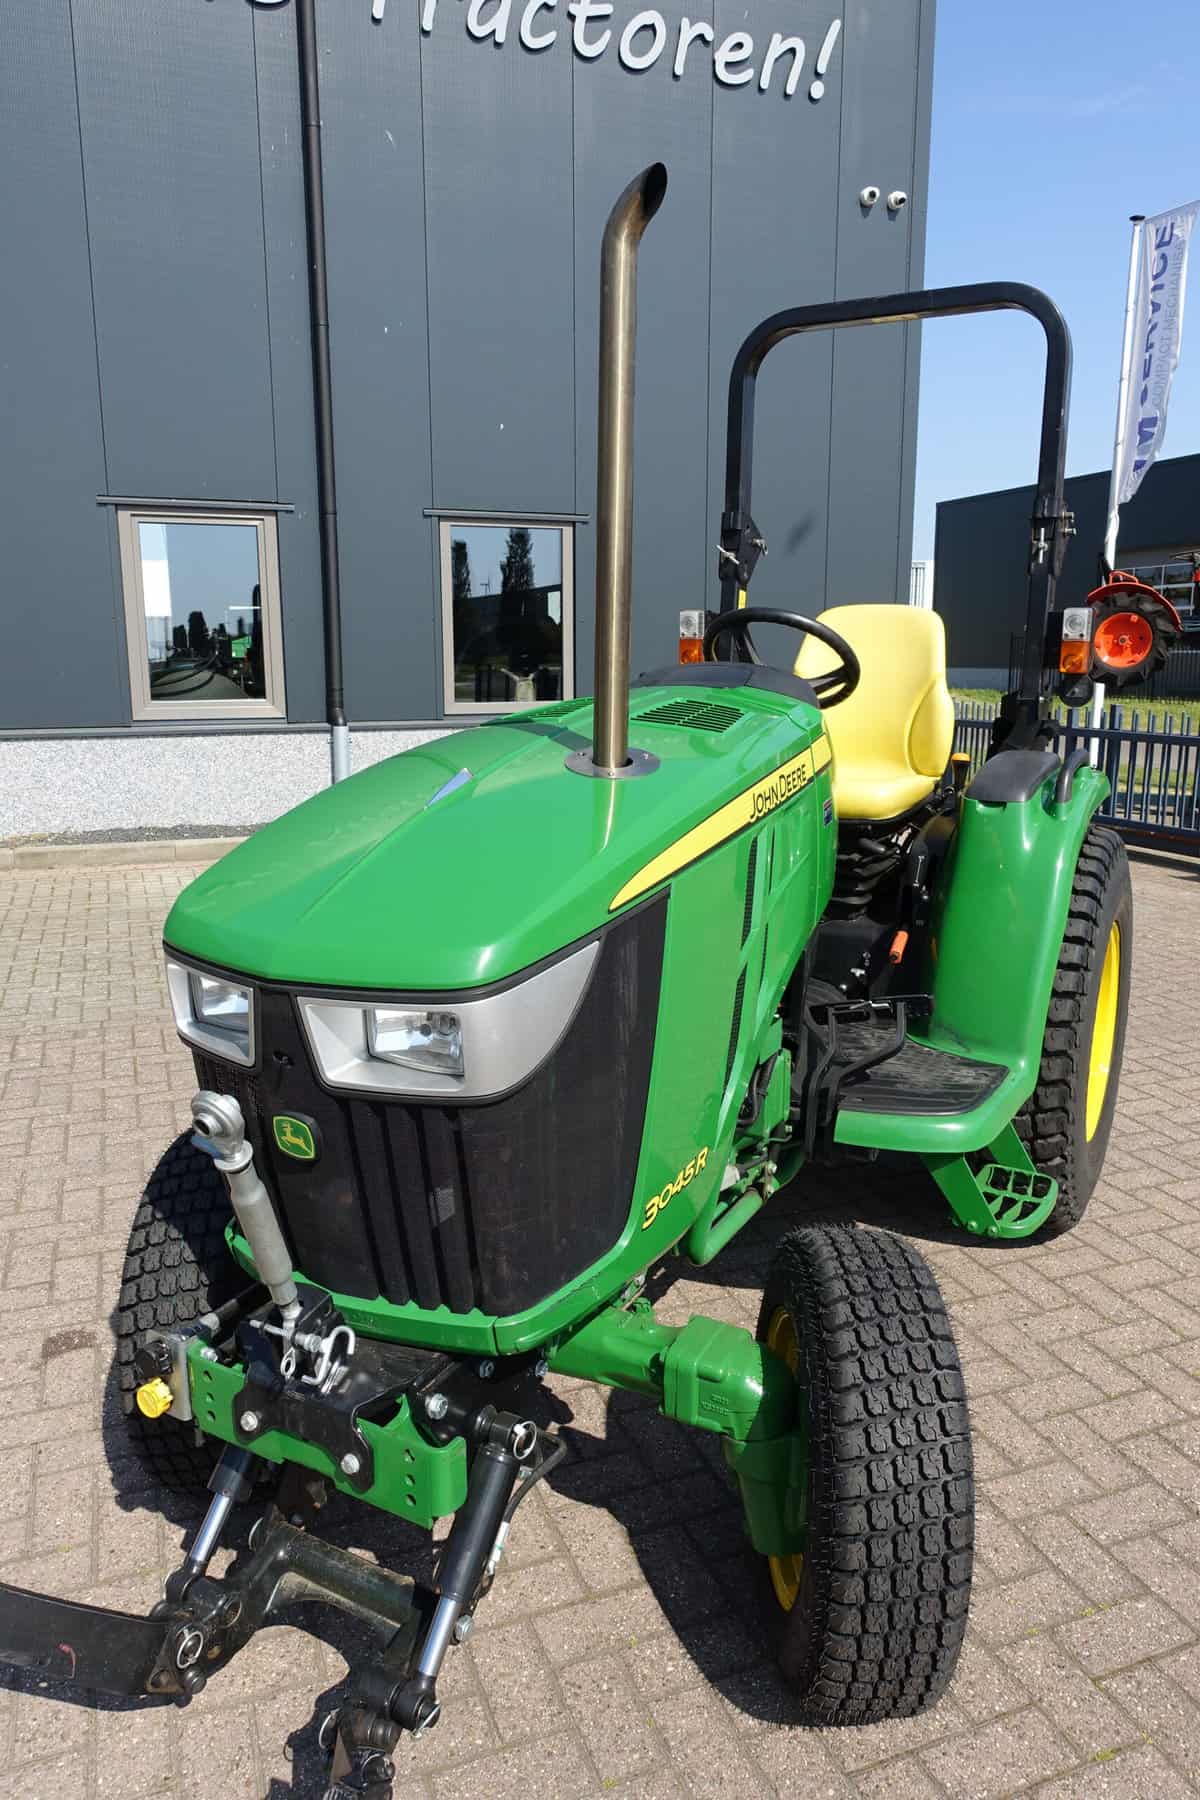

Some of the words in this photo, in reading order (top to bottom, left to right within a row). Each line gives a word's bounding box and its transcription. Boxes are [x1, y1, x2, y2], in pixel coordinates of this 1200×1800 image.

[371, 0, 841, 99] actoren!
[750, 782, 779, 819] JOHN
[778, 763, 807, 799] DEERE
[642, 1146, 709, 1231] 3045R
